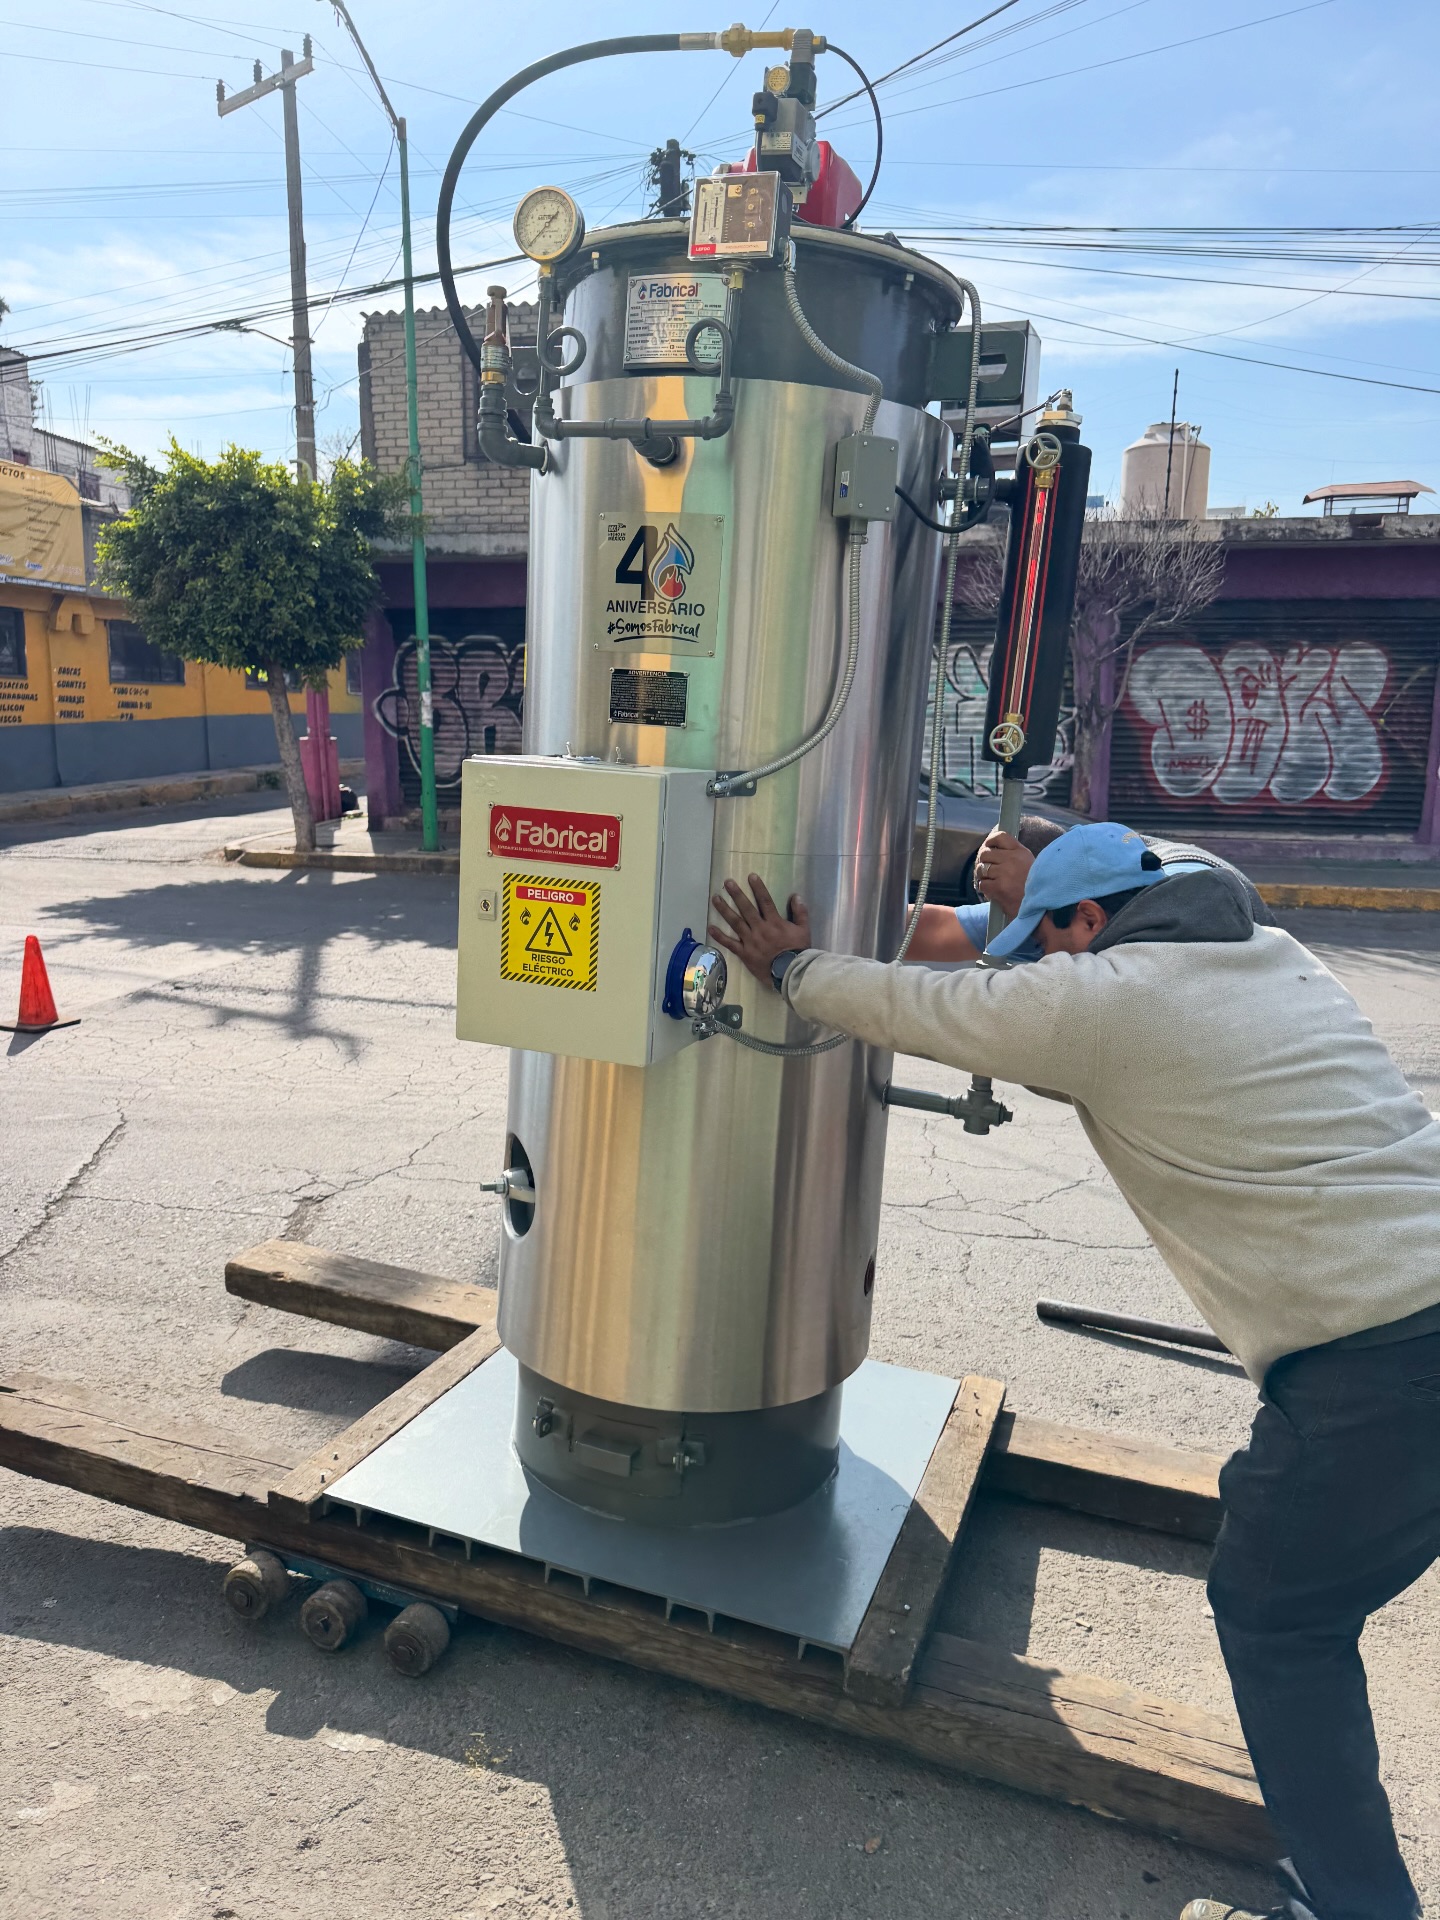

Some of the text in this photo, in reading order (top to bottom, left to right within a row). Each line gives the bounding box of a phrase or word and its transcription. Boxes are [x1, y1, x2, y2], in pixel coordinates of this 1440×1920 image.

[606, 600, 705, 616] ANIVERSARIO
[607, 618, 700, 637] #SomosFabrical
[57, 680, 86, 689] GUANTES
[527, 888, 574, 902] PELIGRO
[531, 953, 566, 965] RIESGO
[522, 962, 574, 977] ELÉCTRICO
